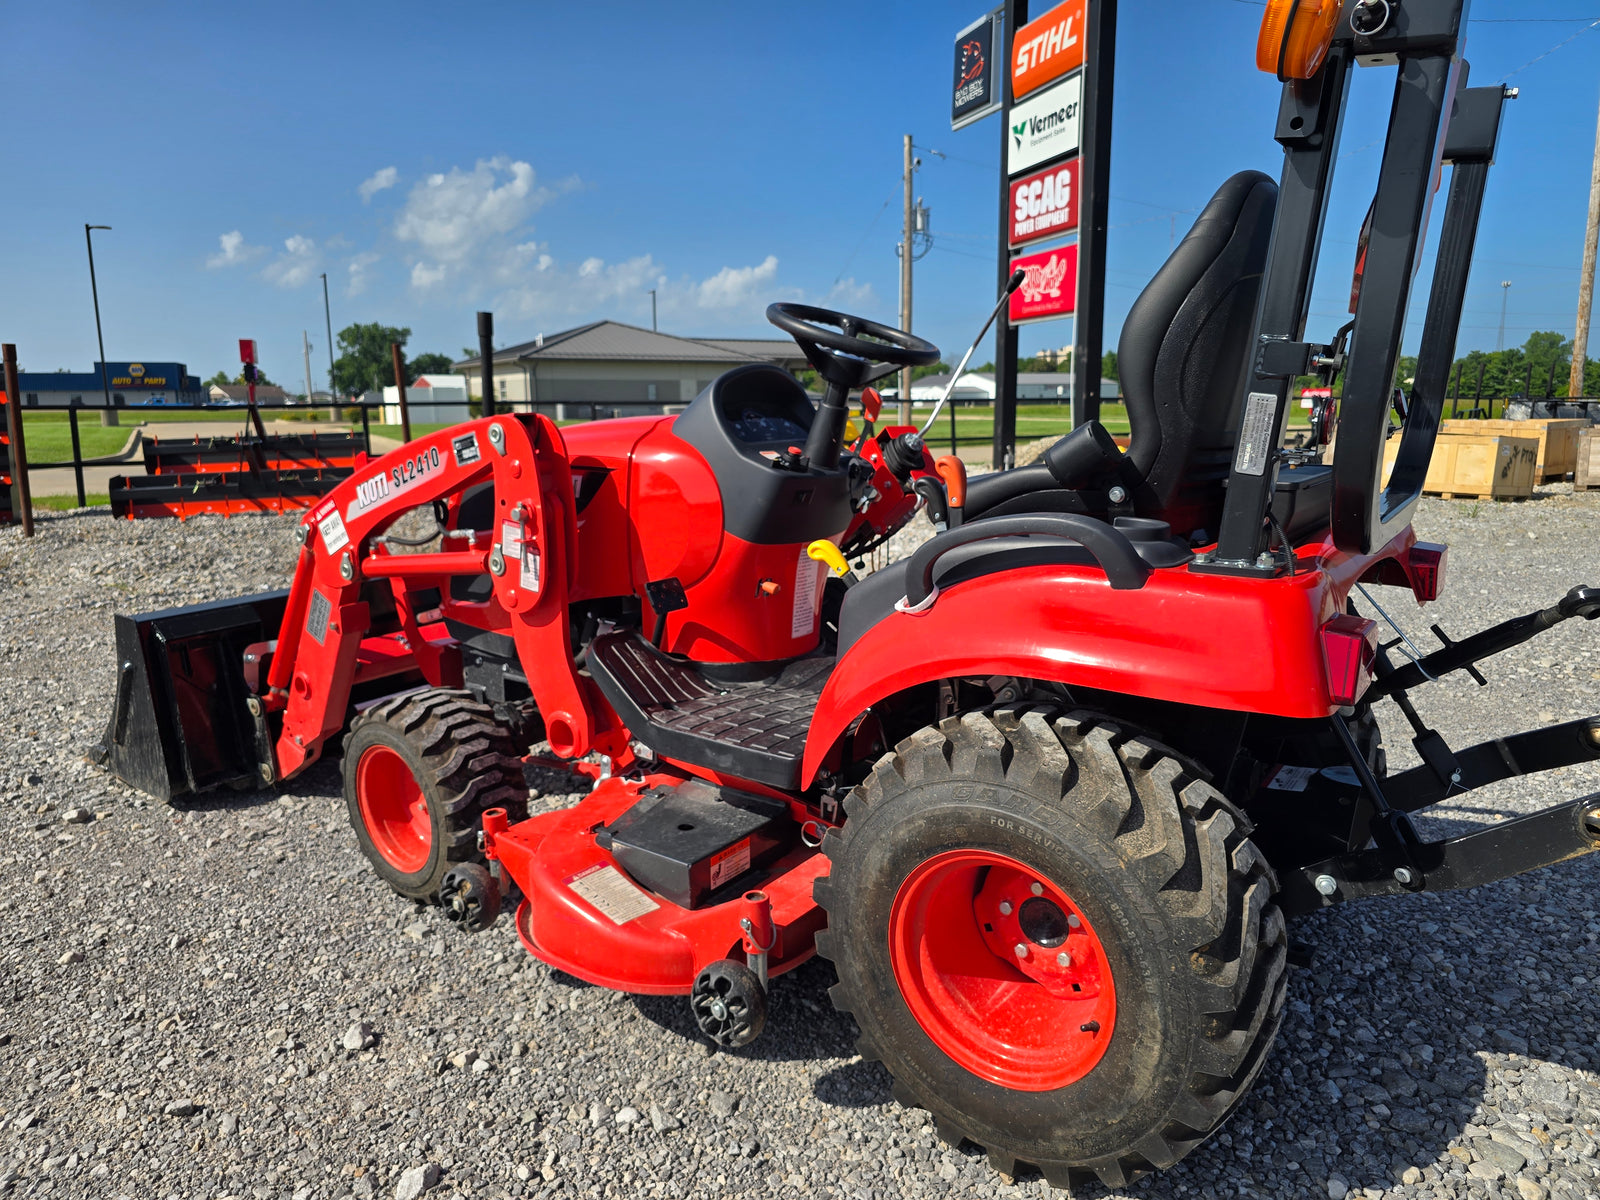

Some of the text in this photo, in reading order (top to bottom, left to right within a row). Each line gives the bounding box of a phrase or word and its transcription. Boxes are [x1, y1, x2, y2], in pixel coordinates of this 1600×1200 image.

[1015, 16, 1078, 77] STIHL
[955, 87, 984, 108] MOWERS
[969, 78, 984, 92] BOY
[1029, 102, 1078, 136] Vermeer
[1015, 169, 1071, 221] SCAG
[1014, 207, 1070, 237] POWER EQUIPMENT
[112, 377, 167, 385] AUTO PARTS
[356, 471, 389, 509] KIOTI
[392, 447, 440, 488] SL2410
[989, 815, 1014, 831] FOR
[1017, 822, 1072, 864] SERVICE
